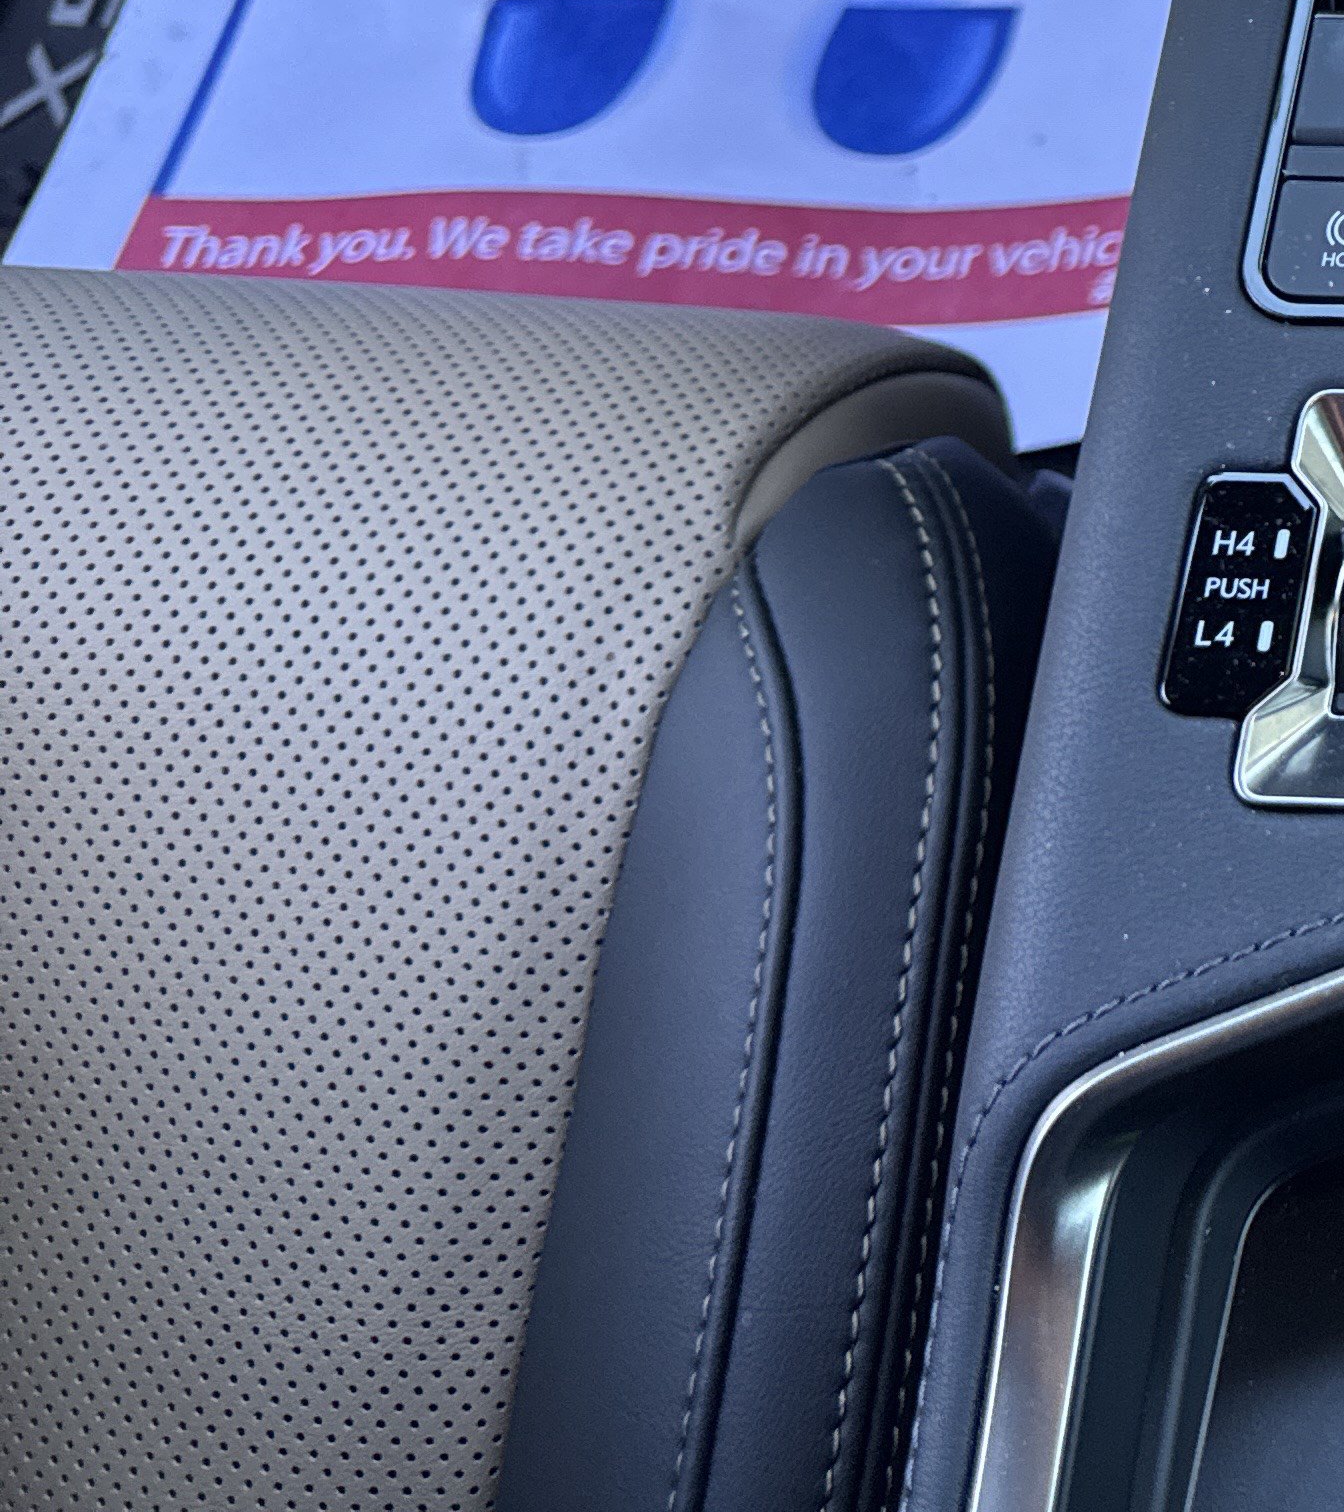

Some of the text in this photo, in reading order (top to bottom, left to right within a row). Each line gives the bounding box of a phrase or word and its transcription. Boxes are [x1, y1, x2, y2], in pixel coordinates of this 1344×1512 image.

[161, 224, 309, 271] Thank
[428, 215, 510, 262] We
[517, 216, 634, 266] take
[638, 227, 788, 278] pride
[793, 232, 848, 279] in
[853, 243, 982, 291] your
[1212, 529, 1255, 558] H4
[1203, 578, 1270, 600] PUSH
[1194, 620, 1235, 648] L4
